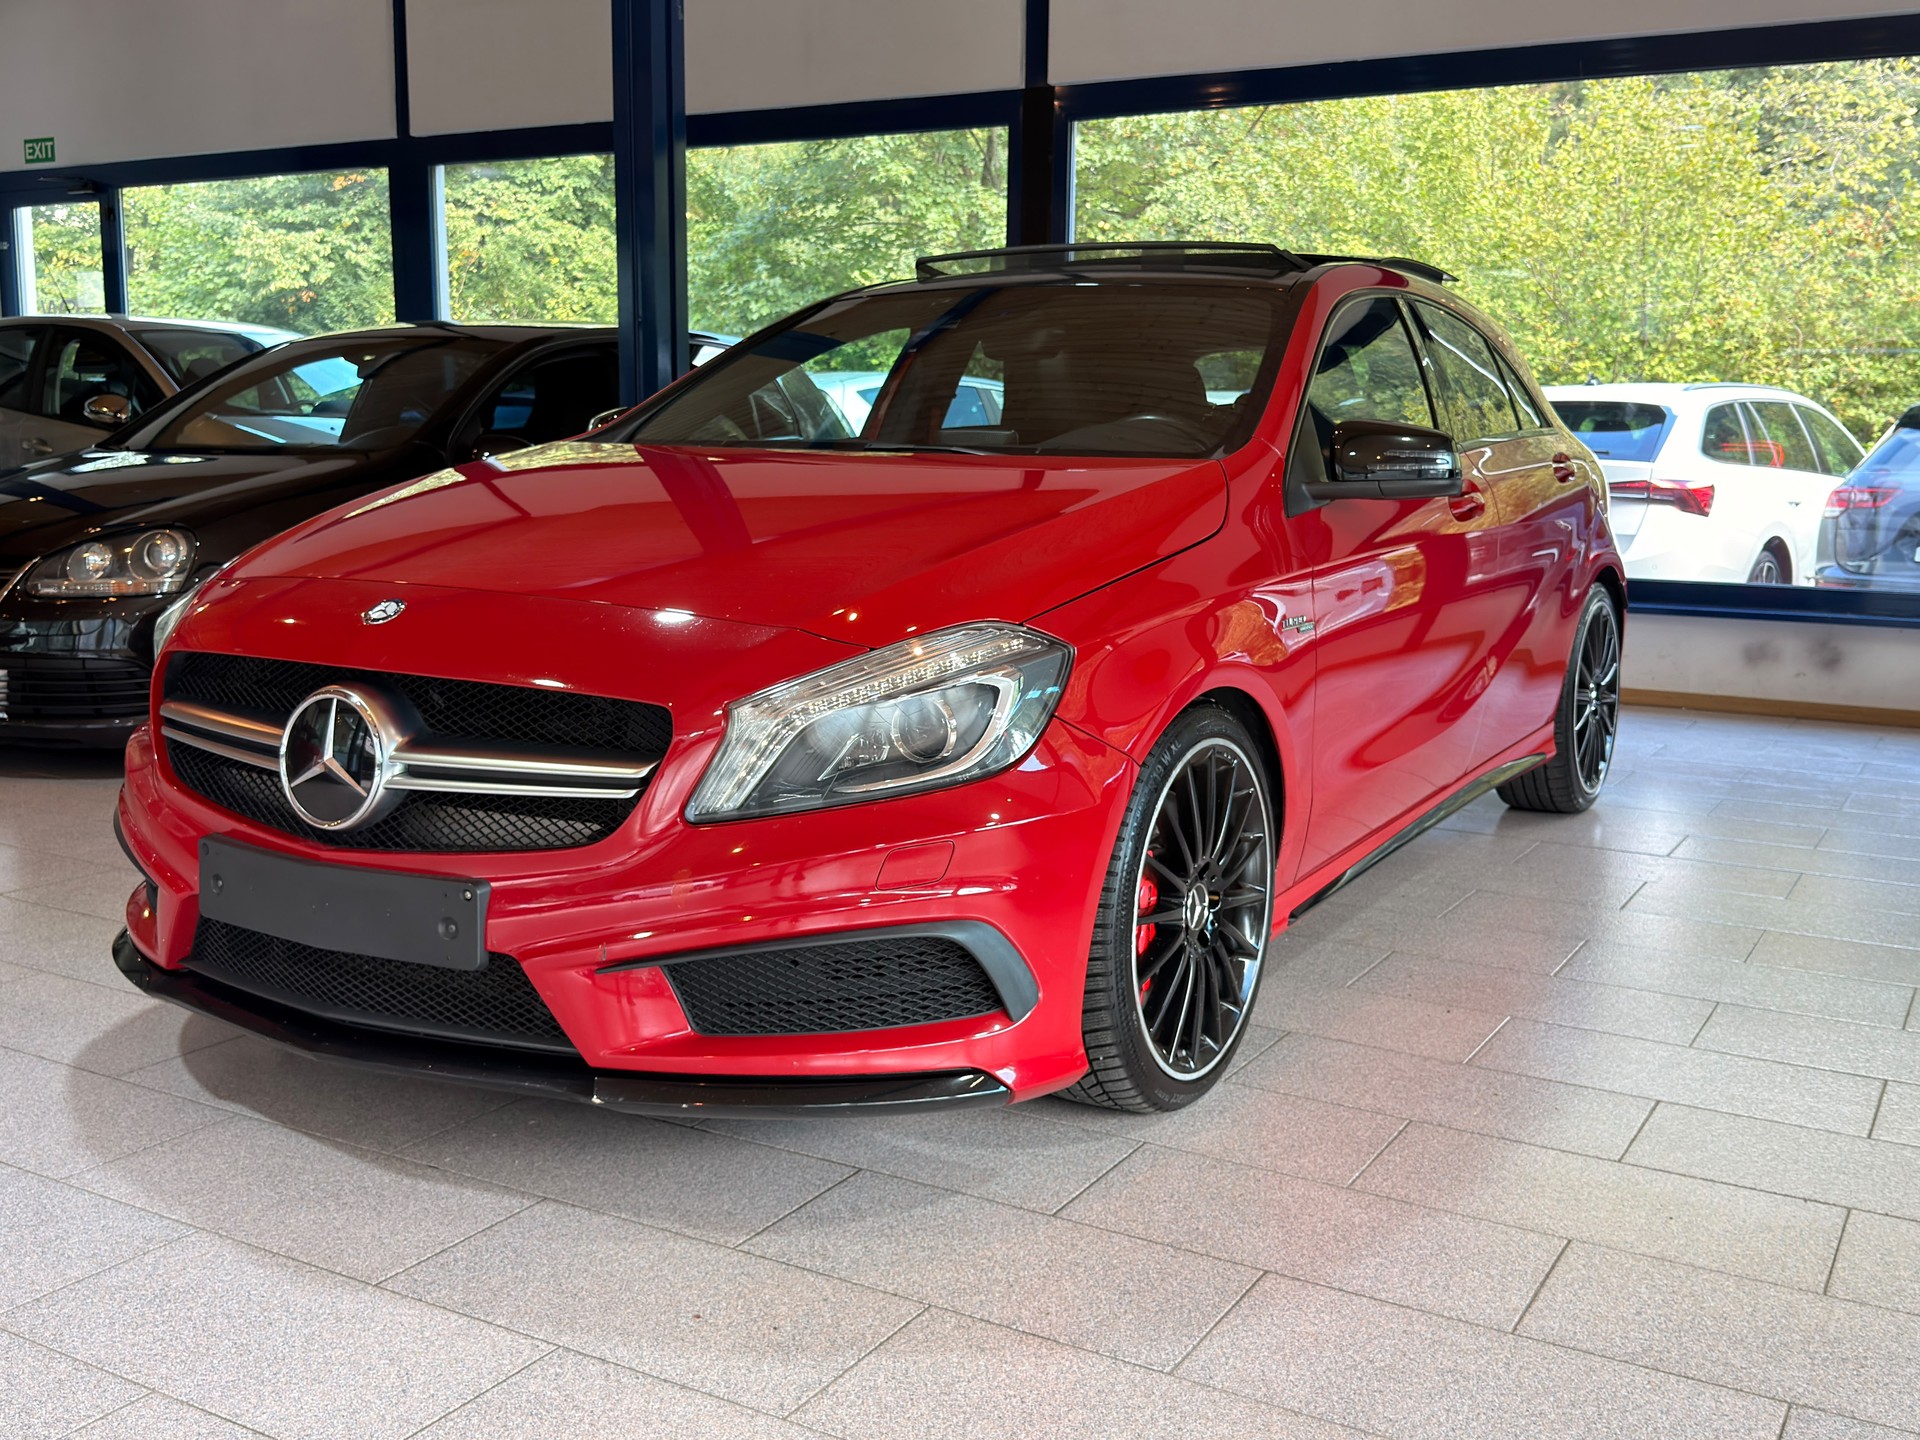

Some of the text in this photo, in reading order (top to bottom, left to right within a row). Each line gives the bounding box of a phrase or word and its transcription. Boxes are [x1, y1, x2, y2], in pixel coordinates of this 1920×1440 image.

[25, 141, 53, 160] EXIT
[1160, 749, 1172, 766] W
[1170, 740, 1182, 755] XL
